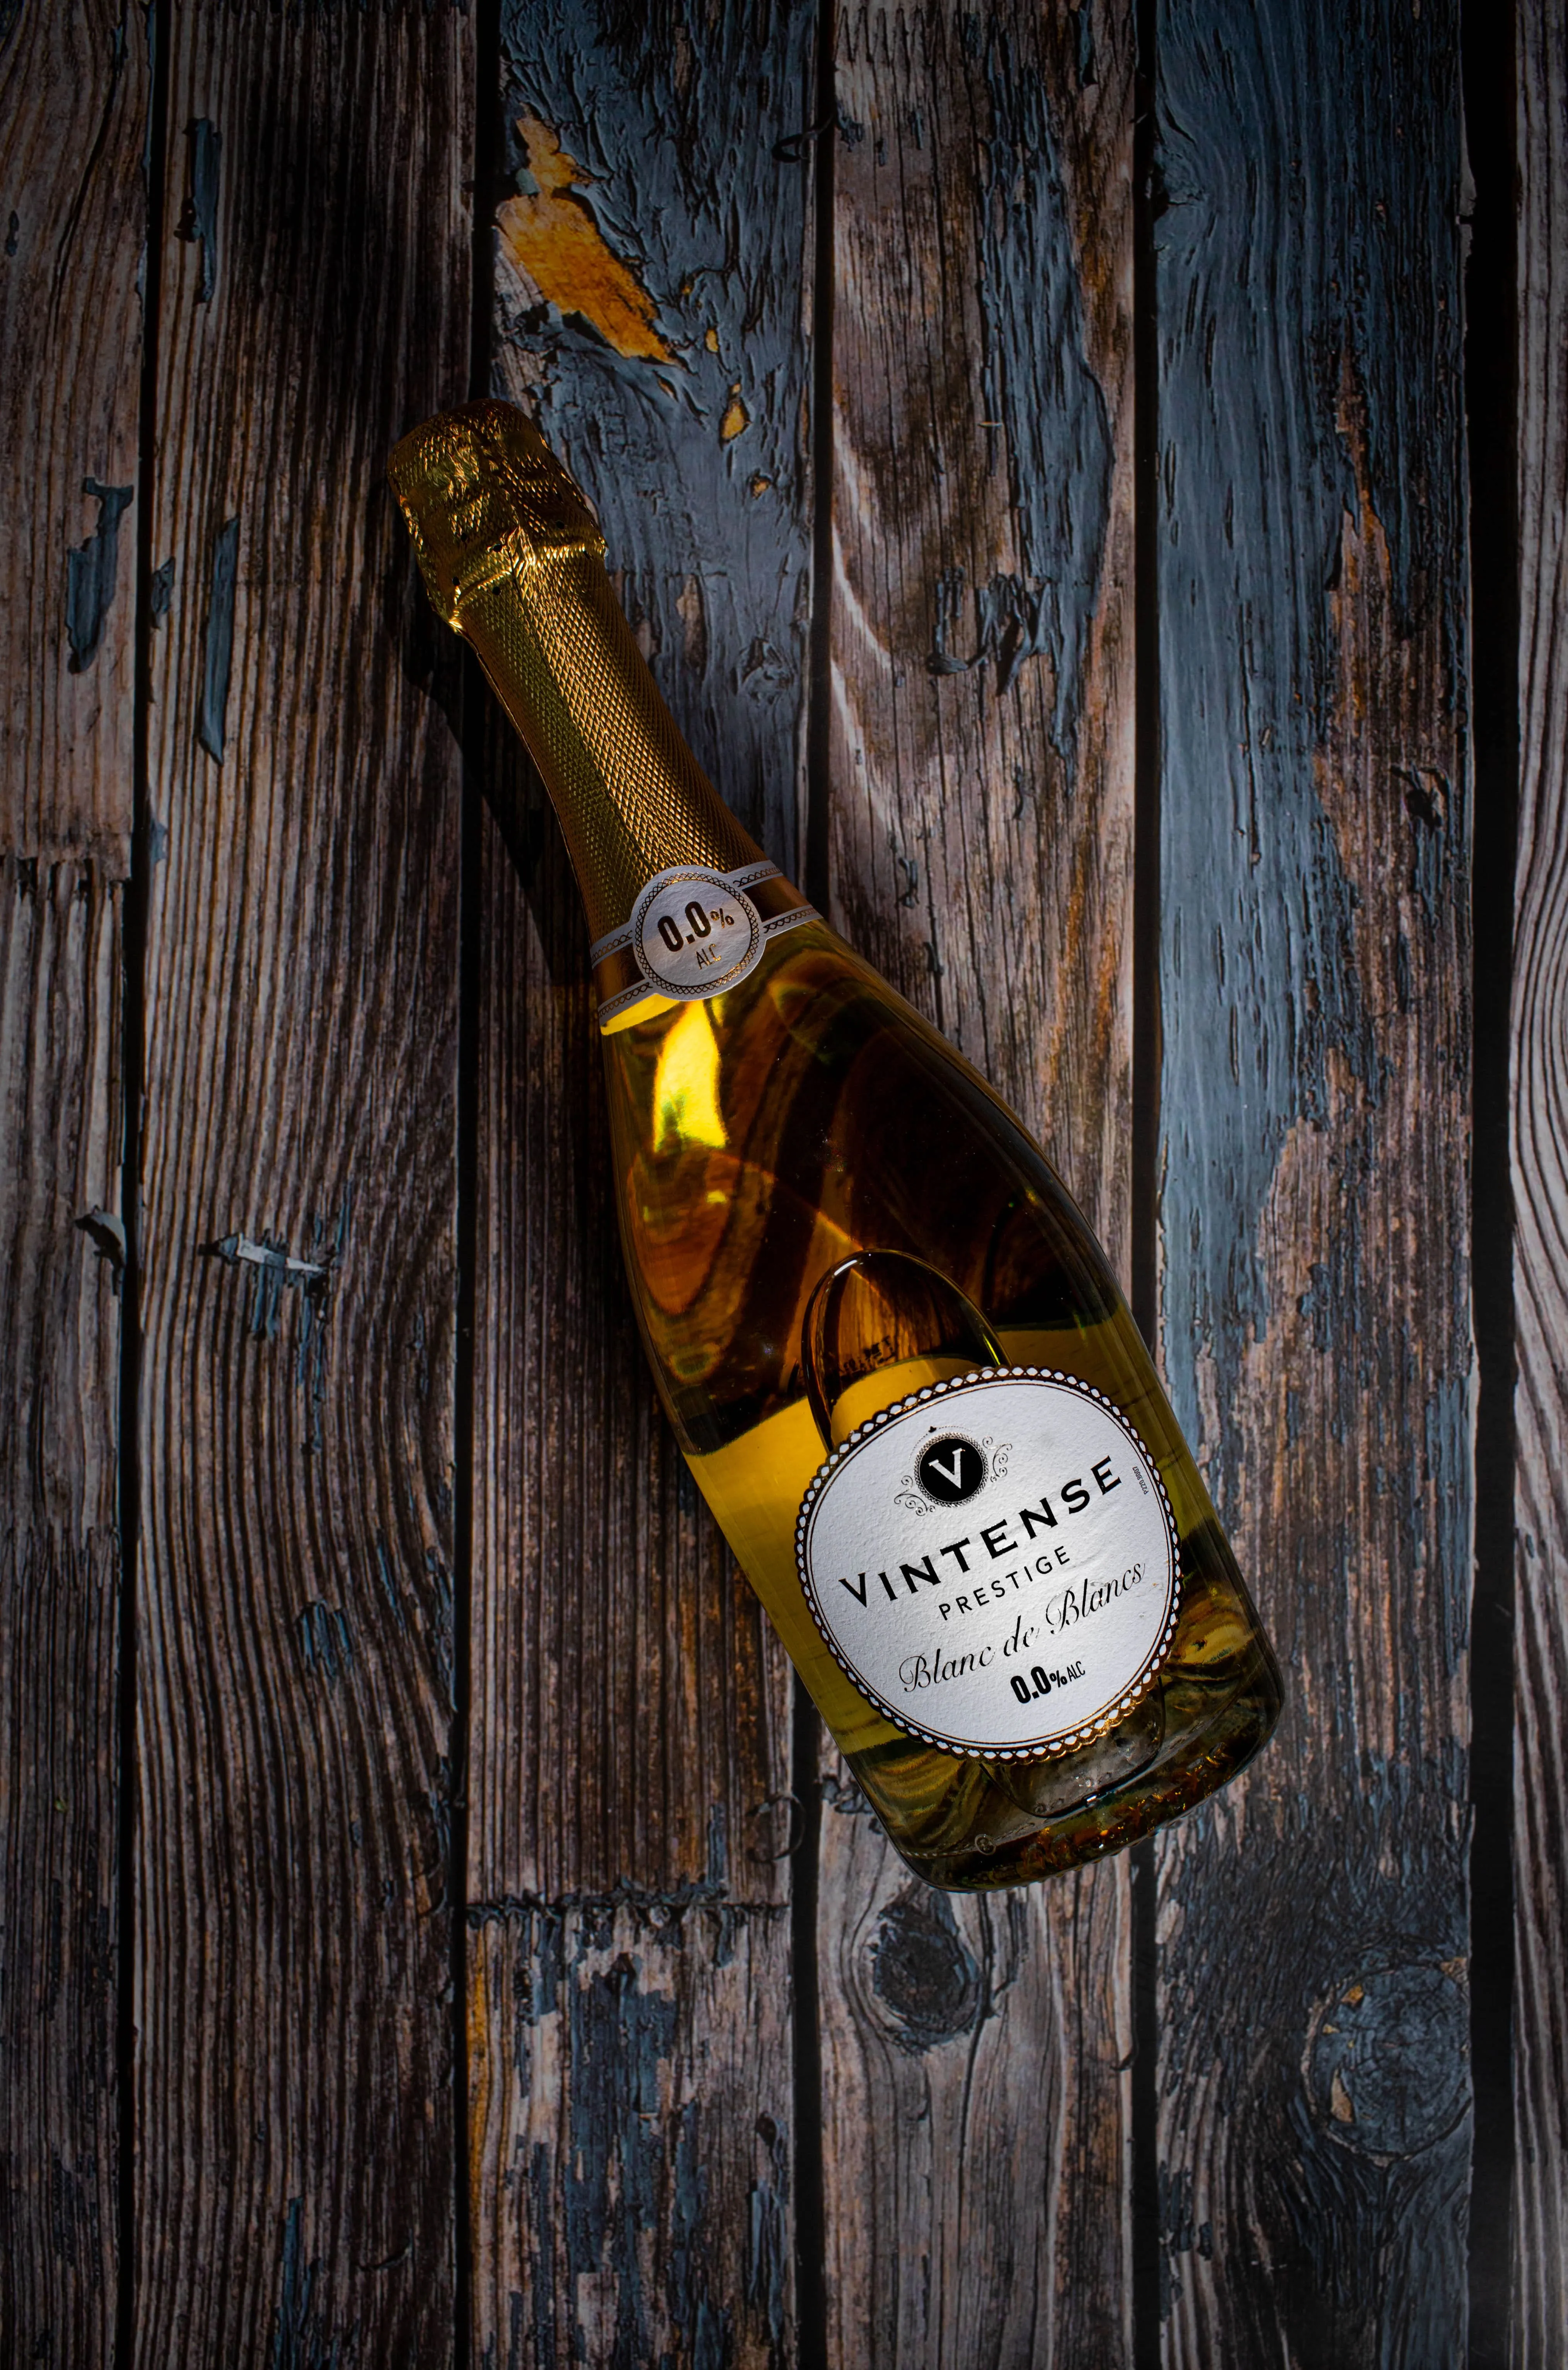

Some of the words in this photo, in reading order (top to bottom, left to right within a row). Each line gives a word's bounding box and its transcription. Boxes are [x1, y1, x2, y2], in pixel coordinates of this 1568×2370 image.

[657, 901, 734, 952] 0.0%
[696, 944, 721, 969] ALC
[929, 1448, 965, 1489] V
[1132, 1466, 1149, 1495] P220.8007
[839, 1455, 1121, 1608] VINTENSE
[939, 1546, 1070, 1620] PRESTIGE
[899, 1646, 995, 1693] Blanc
[1003, 1615, 1039, 1657] de
[1046, 1563, 1146, 1635] Blancs
